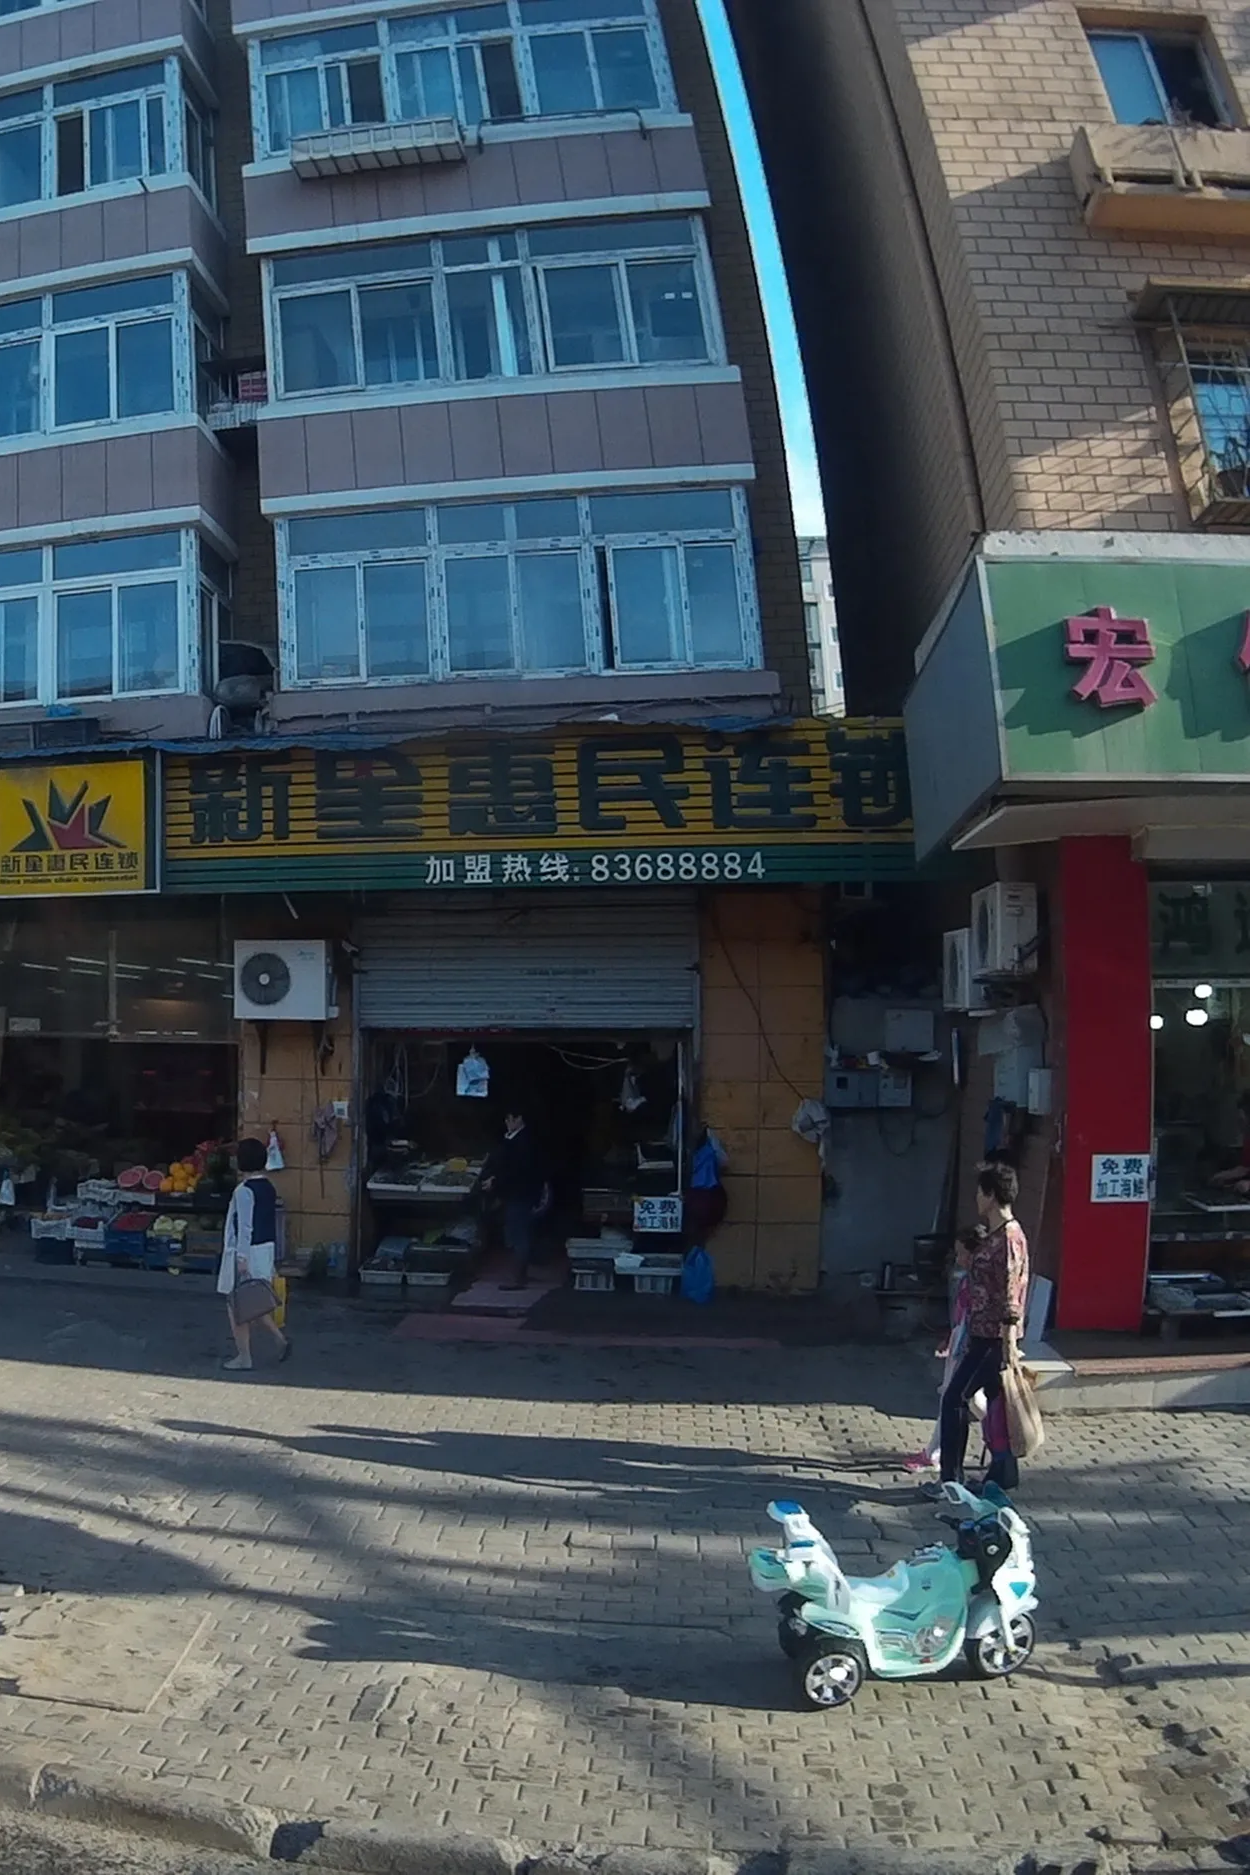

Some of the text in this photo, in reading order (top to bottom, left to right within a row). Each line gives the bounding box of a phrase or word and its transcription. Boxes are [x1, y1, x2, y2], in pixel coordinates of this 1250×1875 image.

[1064, 606, 1158, 708] 宏
[1100, 1157, 1143, 1176] 免费
[639, 1199, 678, 1214] 免费
